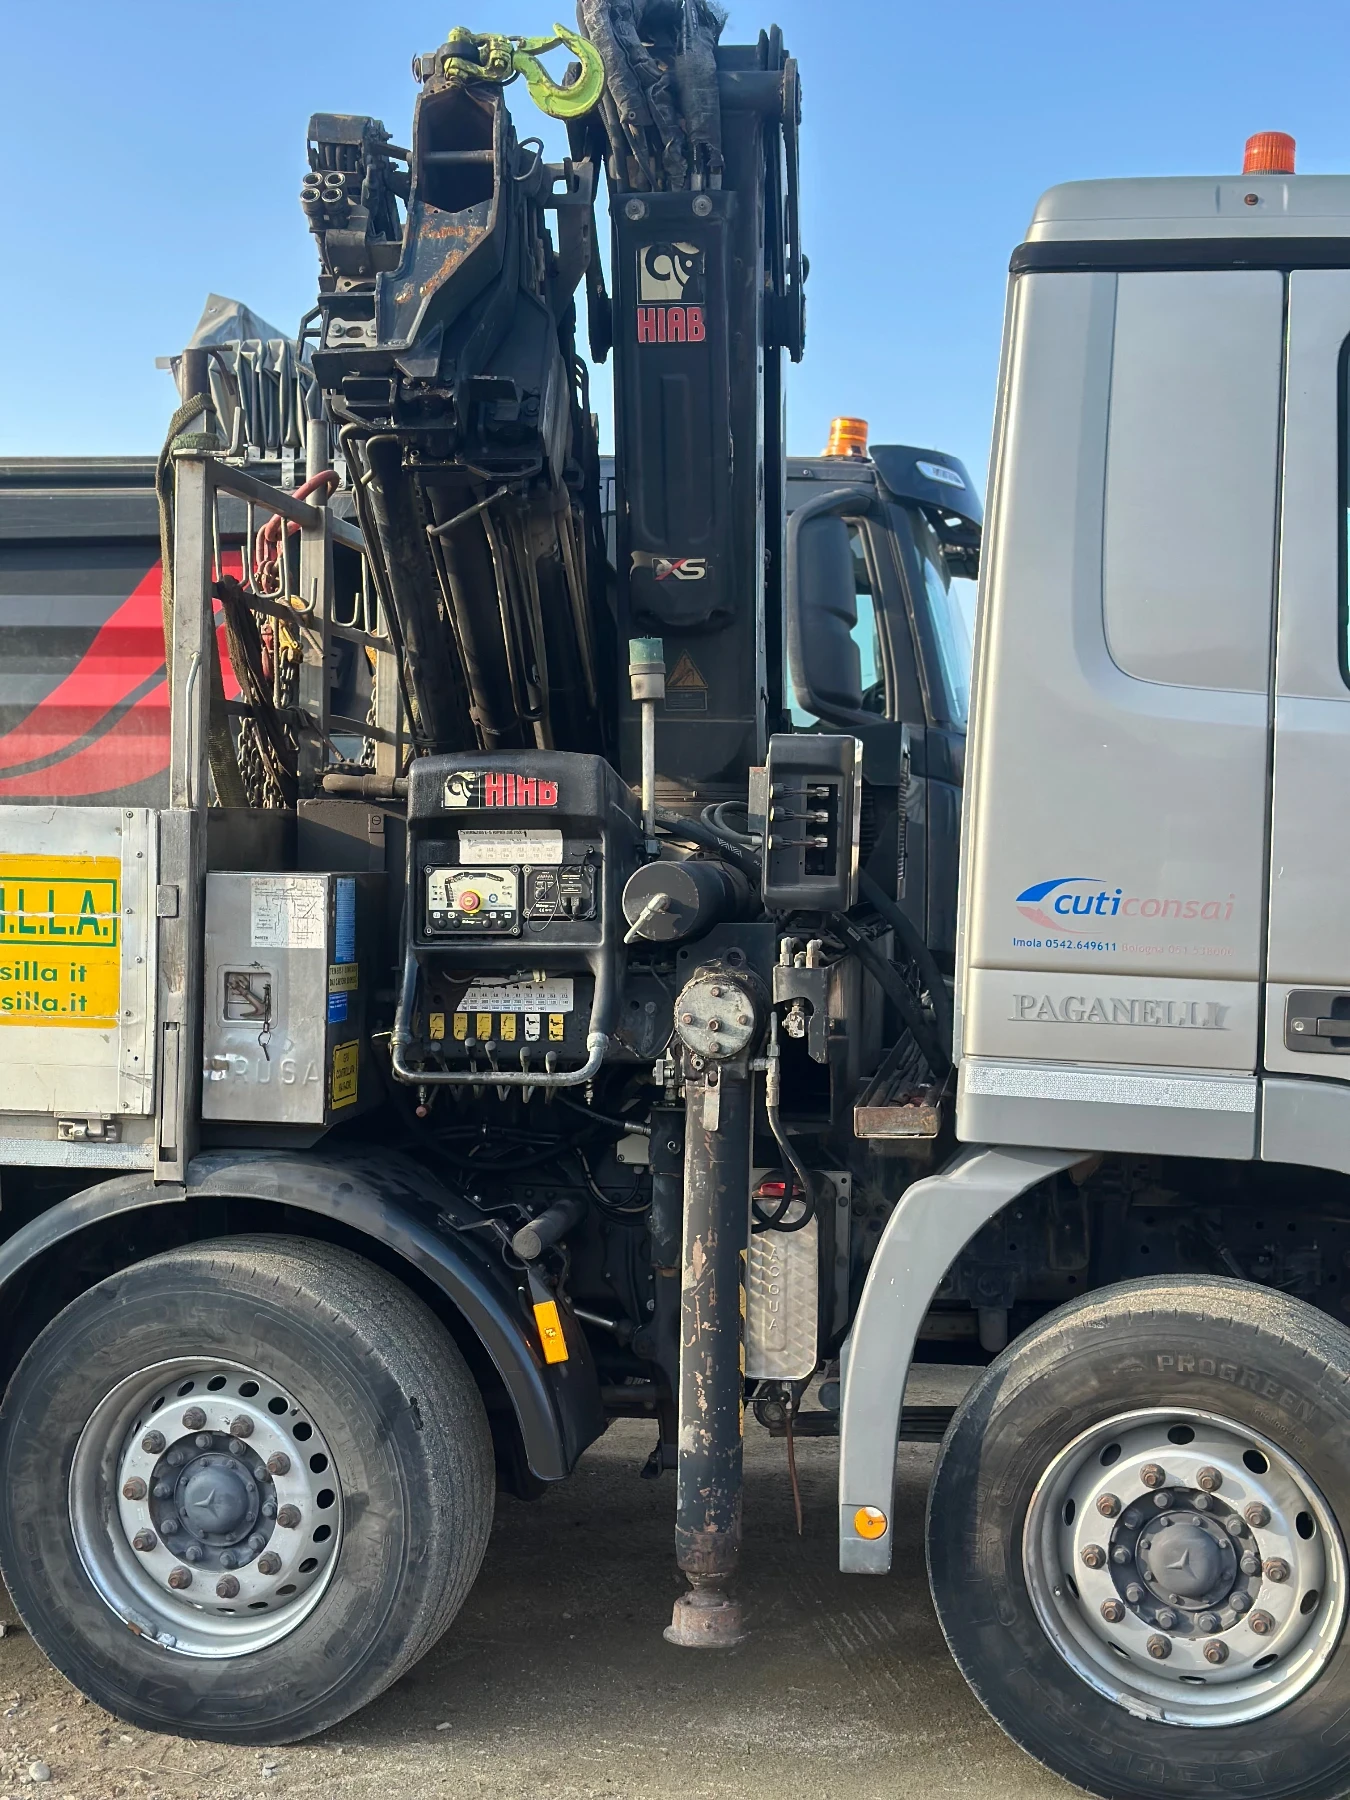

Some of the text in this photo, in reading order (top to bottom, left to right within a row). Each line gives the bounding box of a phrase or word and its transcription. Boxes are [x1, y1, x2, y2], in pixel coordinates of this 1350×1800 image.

[637, 307, 706, 343] HIAB
[655, 558, 706, 580] XS
[1013, 938, 1042, 948] Imola
[1045, 939, 1117, 952] 0542.649611
[2, 991, 87, 1012] silla.it
[1011, 993, 1227, 1029] PAGANELLI
[1156, 1353, 1318, 1424] PROGREEN
